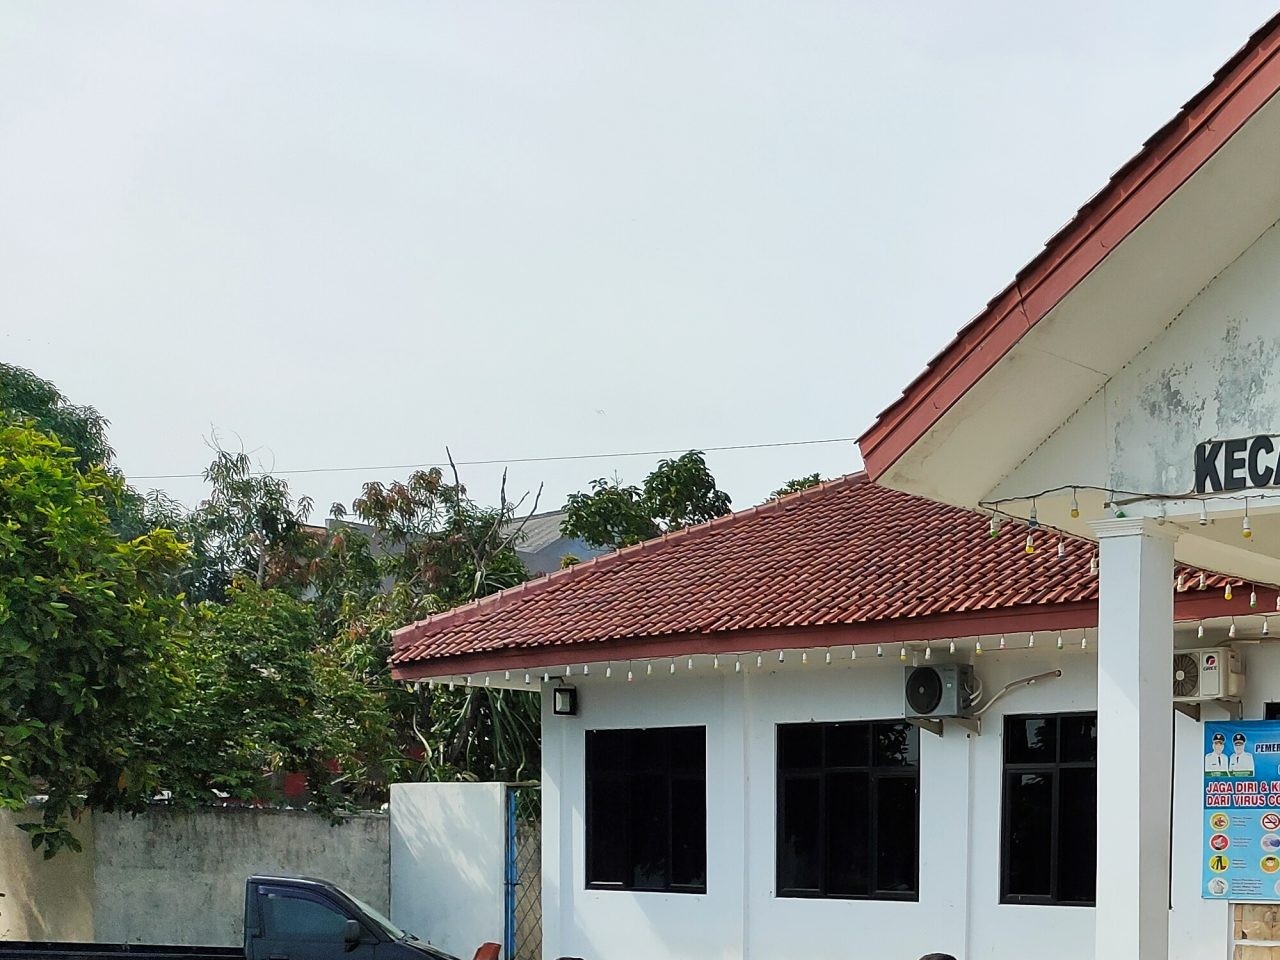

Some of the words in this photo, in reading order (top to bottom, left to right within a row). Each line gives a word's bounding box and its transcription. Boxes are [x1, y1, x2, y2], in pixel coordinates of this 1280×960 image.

[1206, 783, 1233, 793] JAGA
[1235, 782, 1258, 793] DIRI
[1260, 783, 1267, 792] &
[1206, 796, 1230, 806] DARI
[1234, 795, 1266, 806] VIRUS
